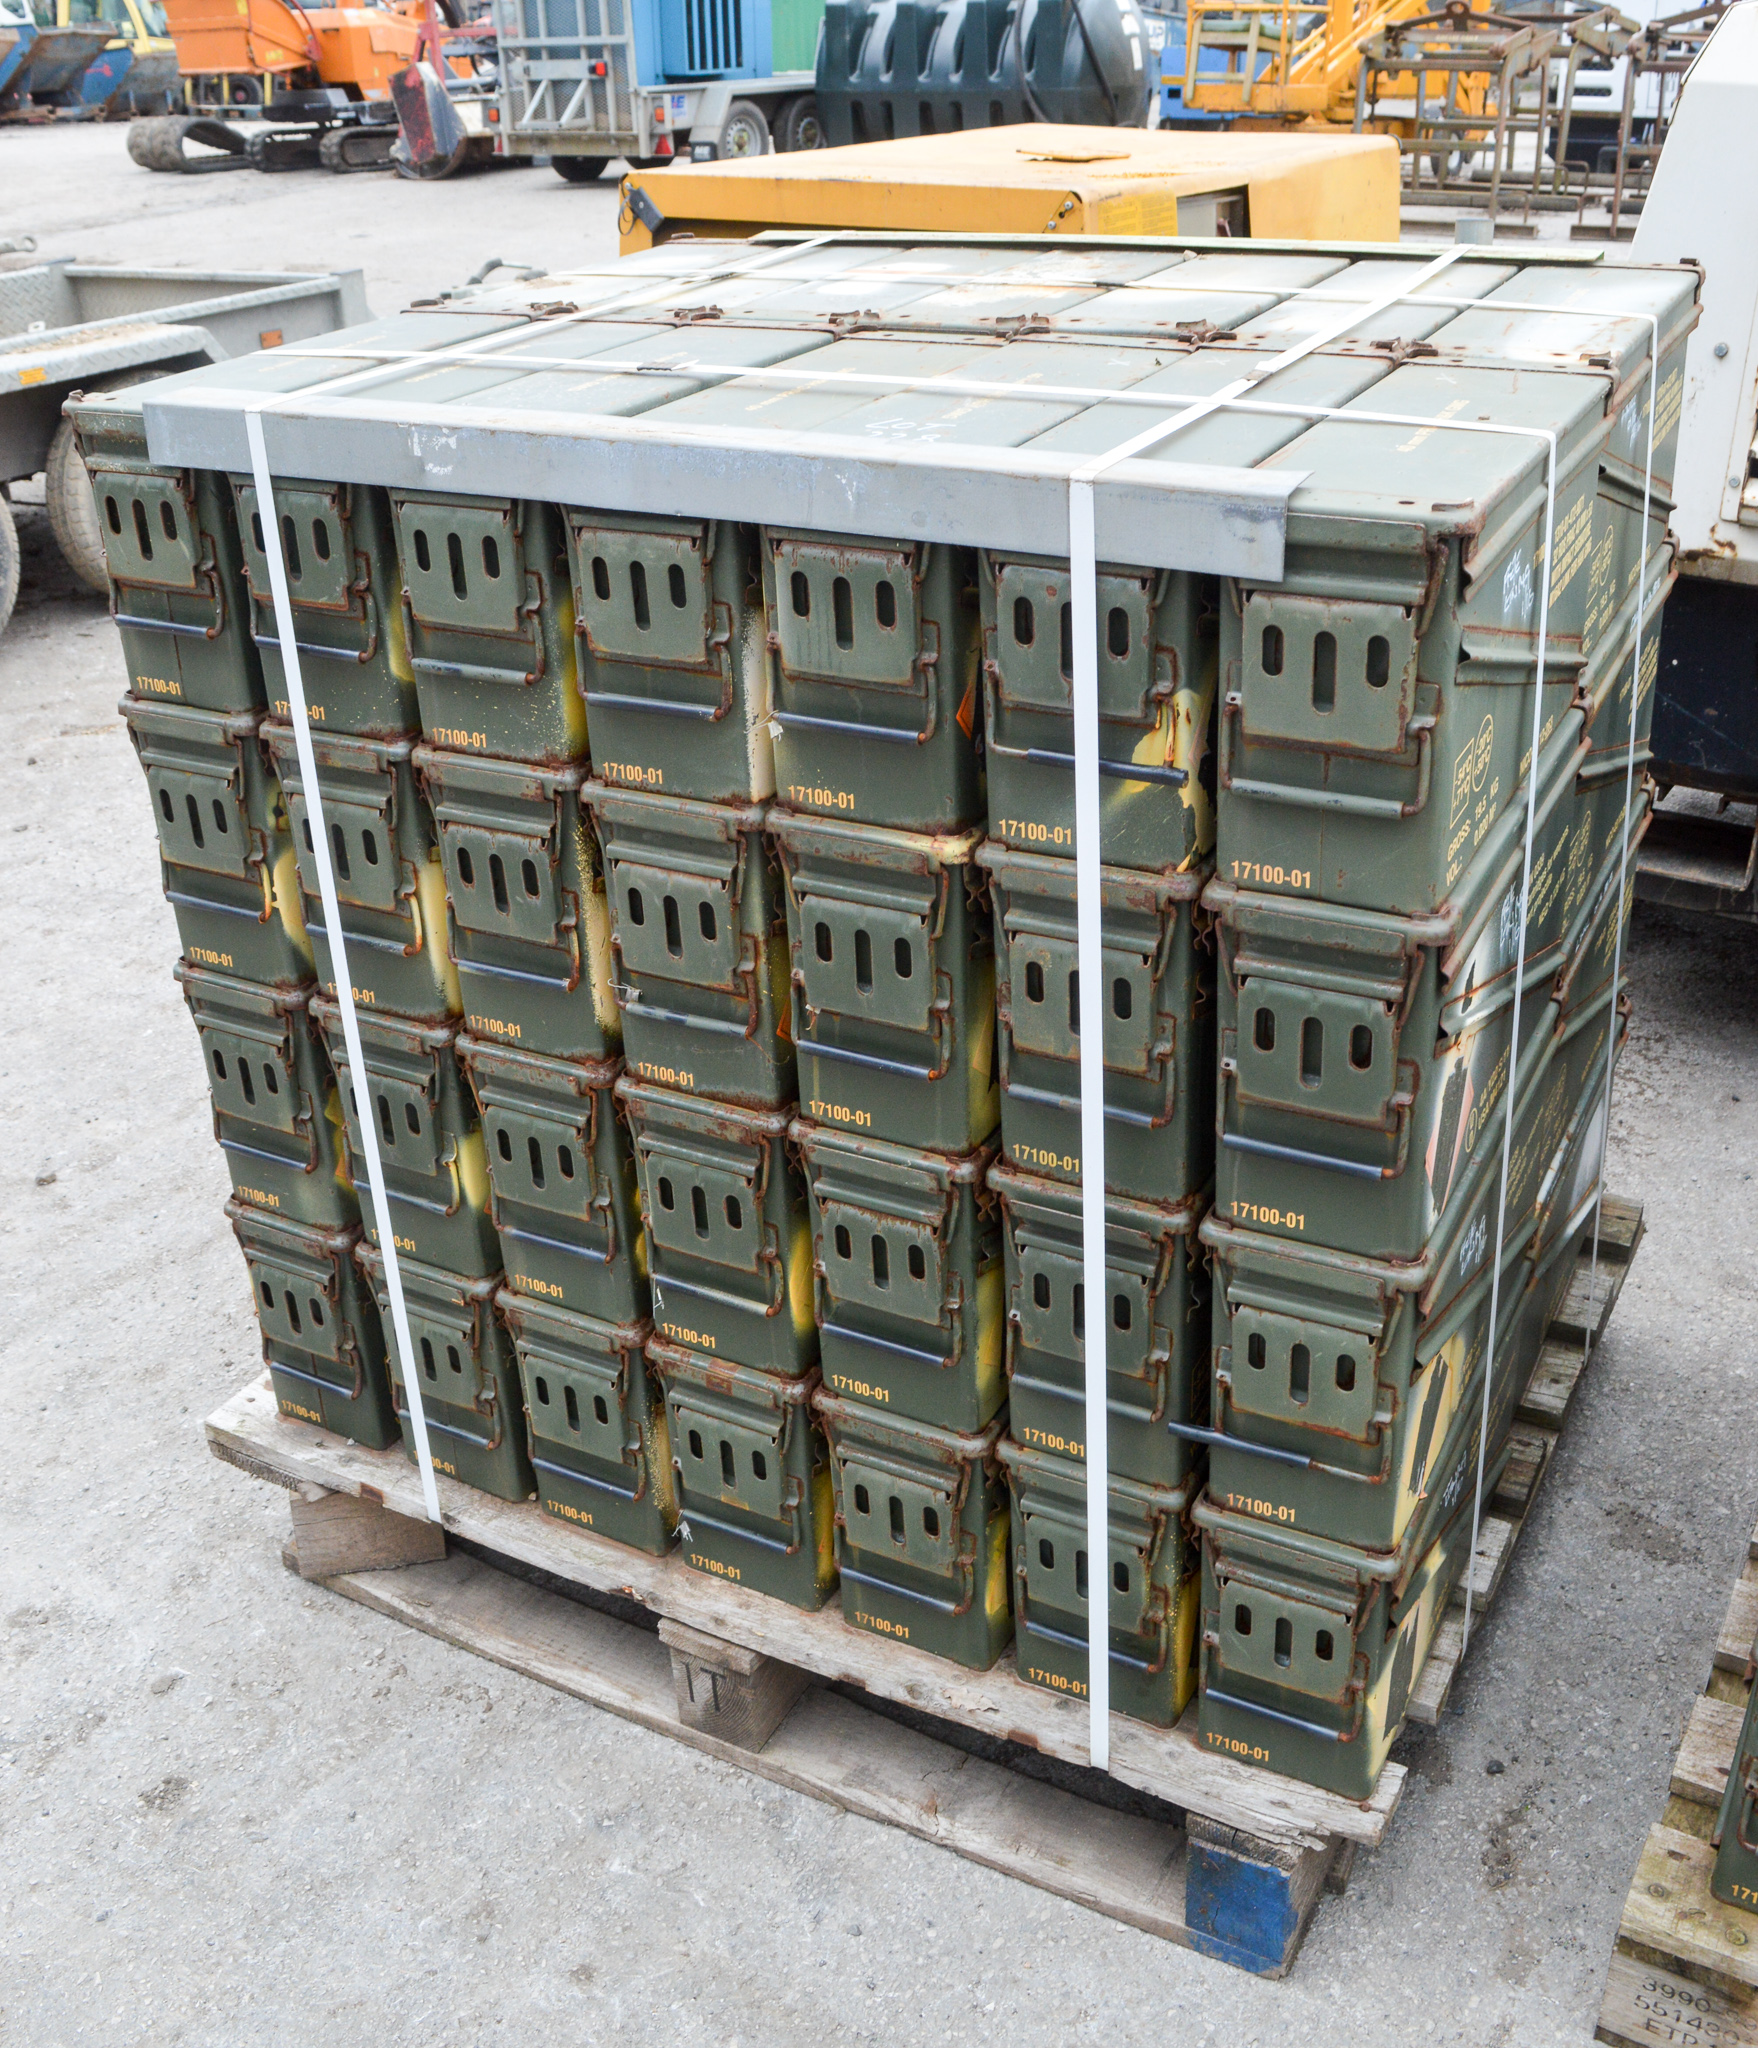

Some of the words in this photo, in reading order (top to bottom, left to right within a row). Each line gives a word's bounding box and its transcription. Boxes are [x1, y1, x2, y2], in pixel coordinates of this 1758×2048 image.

[865, 417, 957, 431] LOT
[136, 676, 181, 696] 17100-01
[432, 727, 487, 748] 17100-01
[602, 761, 663, 785] 17100-01
[788, 785, 854, 810] 17100-01
[999, 819, 1072, 844] 17100-01
[1447, 818, 1471, 862] GROSS:
[1490, 776, 1499, 800] KG
[1231, 860, 1311, 889] 17100-01
[189, 947, 233, 968] 17100-01
[469, 1014, 521, 1038] 17100-01
[638, 1062, 694, 1086] 17100-01
[809, 1100, 871, 1127] 17100-01
[1013, 1144, 1080, 1172] 17100-01
[238, 1185, 280, 1207] 17100-01
[1230, 1201, 1305, 1230] 17100-01
[514, 1274, 563, 1299] 17100-01
[662, 1322, 716, 1349] 17100-01
[832, 1374, 890, 1402] 17100-01
[282, 1399, 320, 1423] 17100-01
[1023, 1427, 1084, 1457] 17100-01
[546, 1499, 593, 1525] 17100-01
[1227, 1493, 1296, 1522] 17100-01
[690, 1553, 741, 1580] 17100-01
[854, 1611, 910, 1639] 17100-01
[1028, 1667, 1087, 1695] 17100-01
[1206, 1732, 1270, 1762] 17100-01
